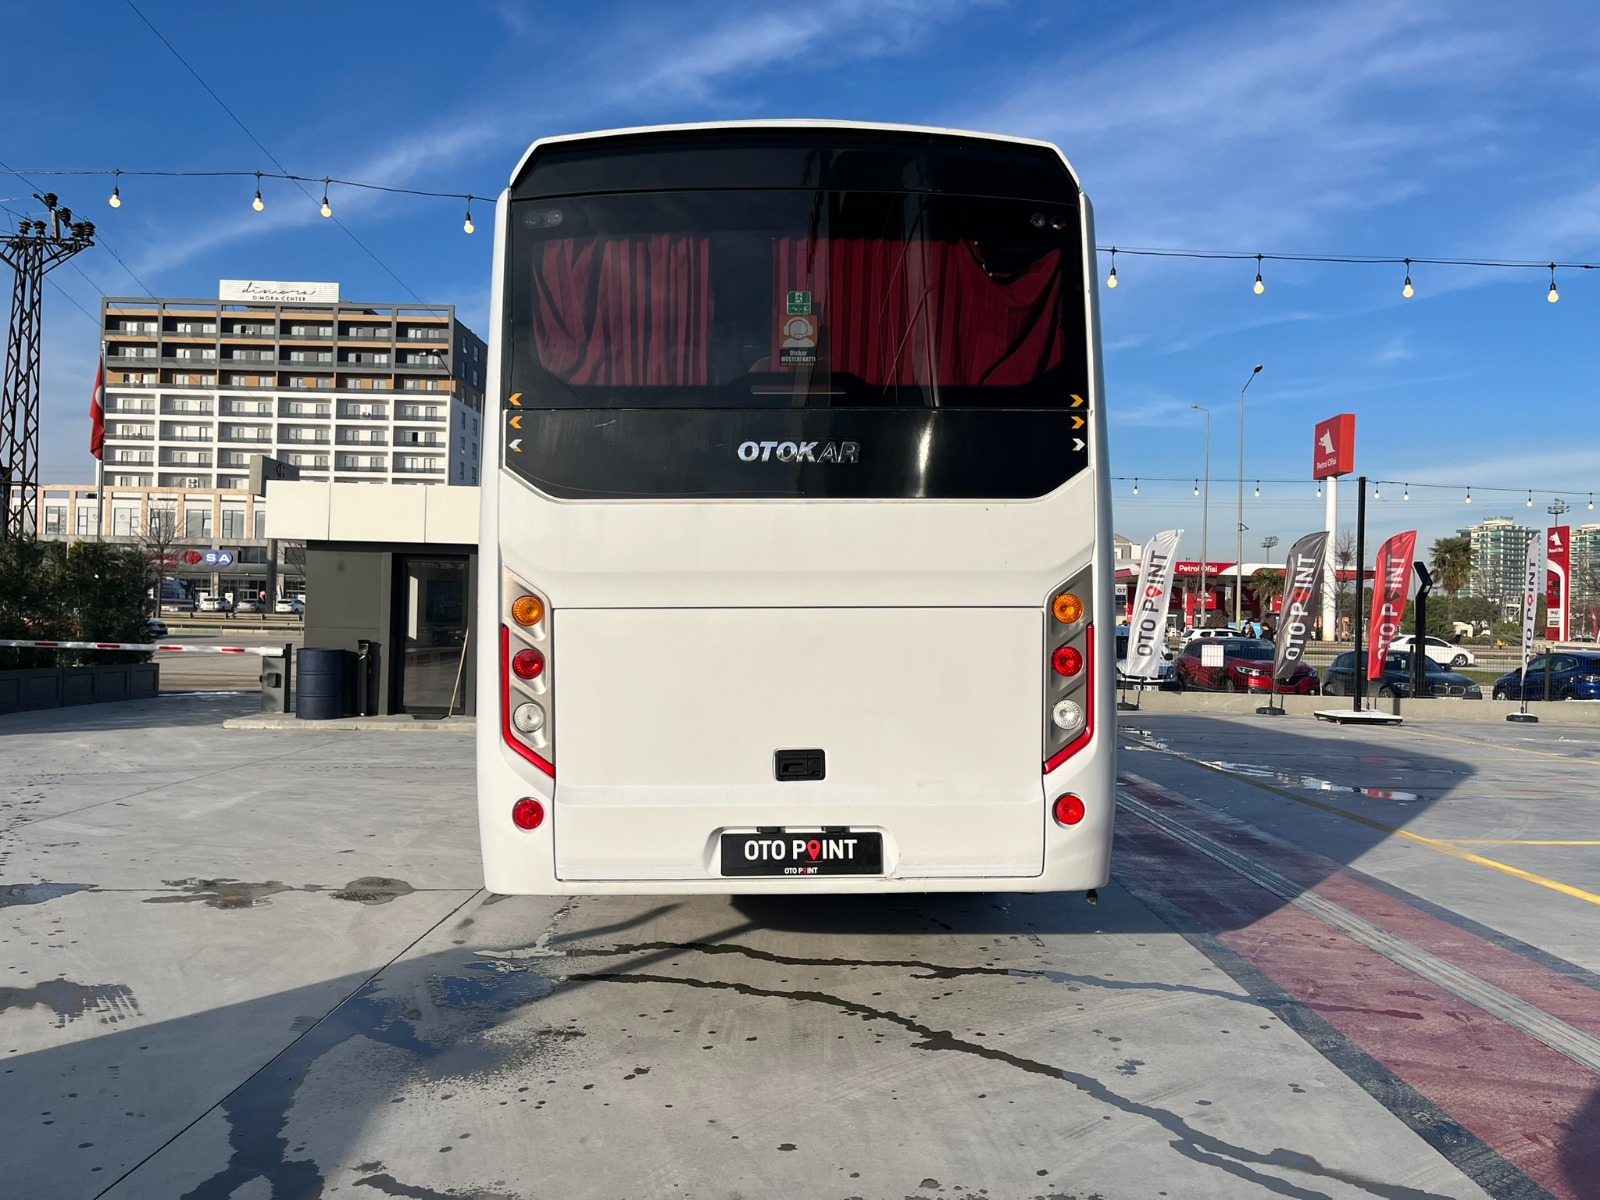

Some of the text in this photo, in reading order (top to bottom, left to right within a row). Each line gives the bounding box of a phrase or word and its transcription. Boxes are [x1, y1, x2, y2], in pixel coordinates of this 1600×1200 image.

[737, 441, 861, 463] OTOKAR
[1142, 550, 1168, 613] POINT
[1178, 564, 1200, 572] Petrol
[1381, 554, 1405, 616] POINT
[1285, 553, 1316, 661] OTO POINT
[1136, 618, 1156, 657] OTO
[744, 839, 858, 861] OTO POINT
